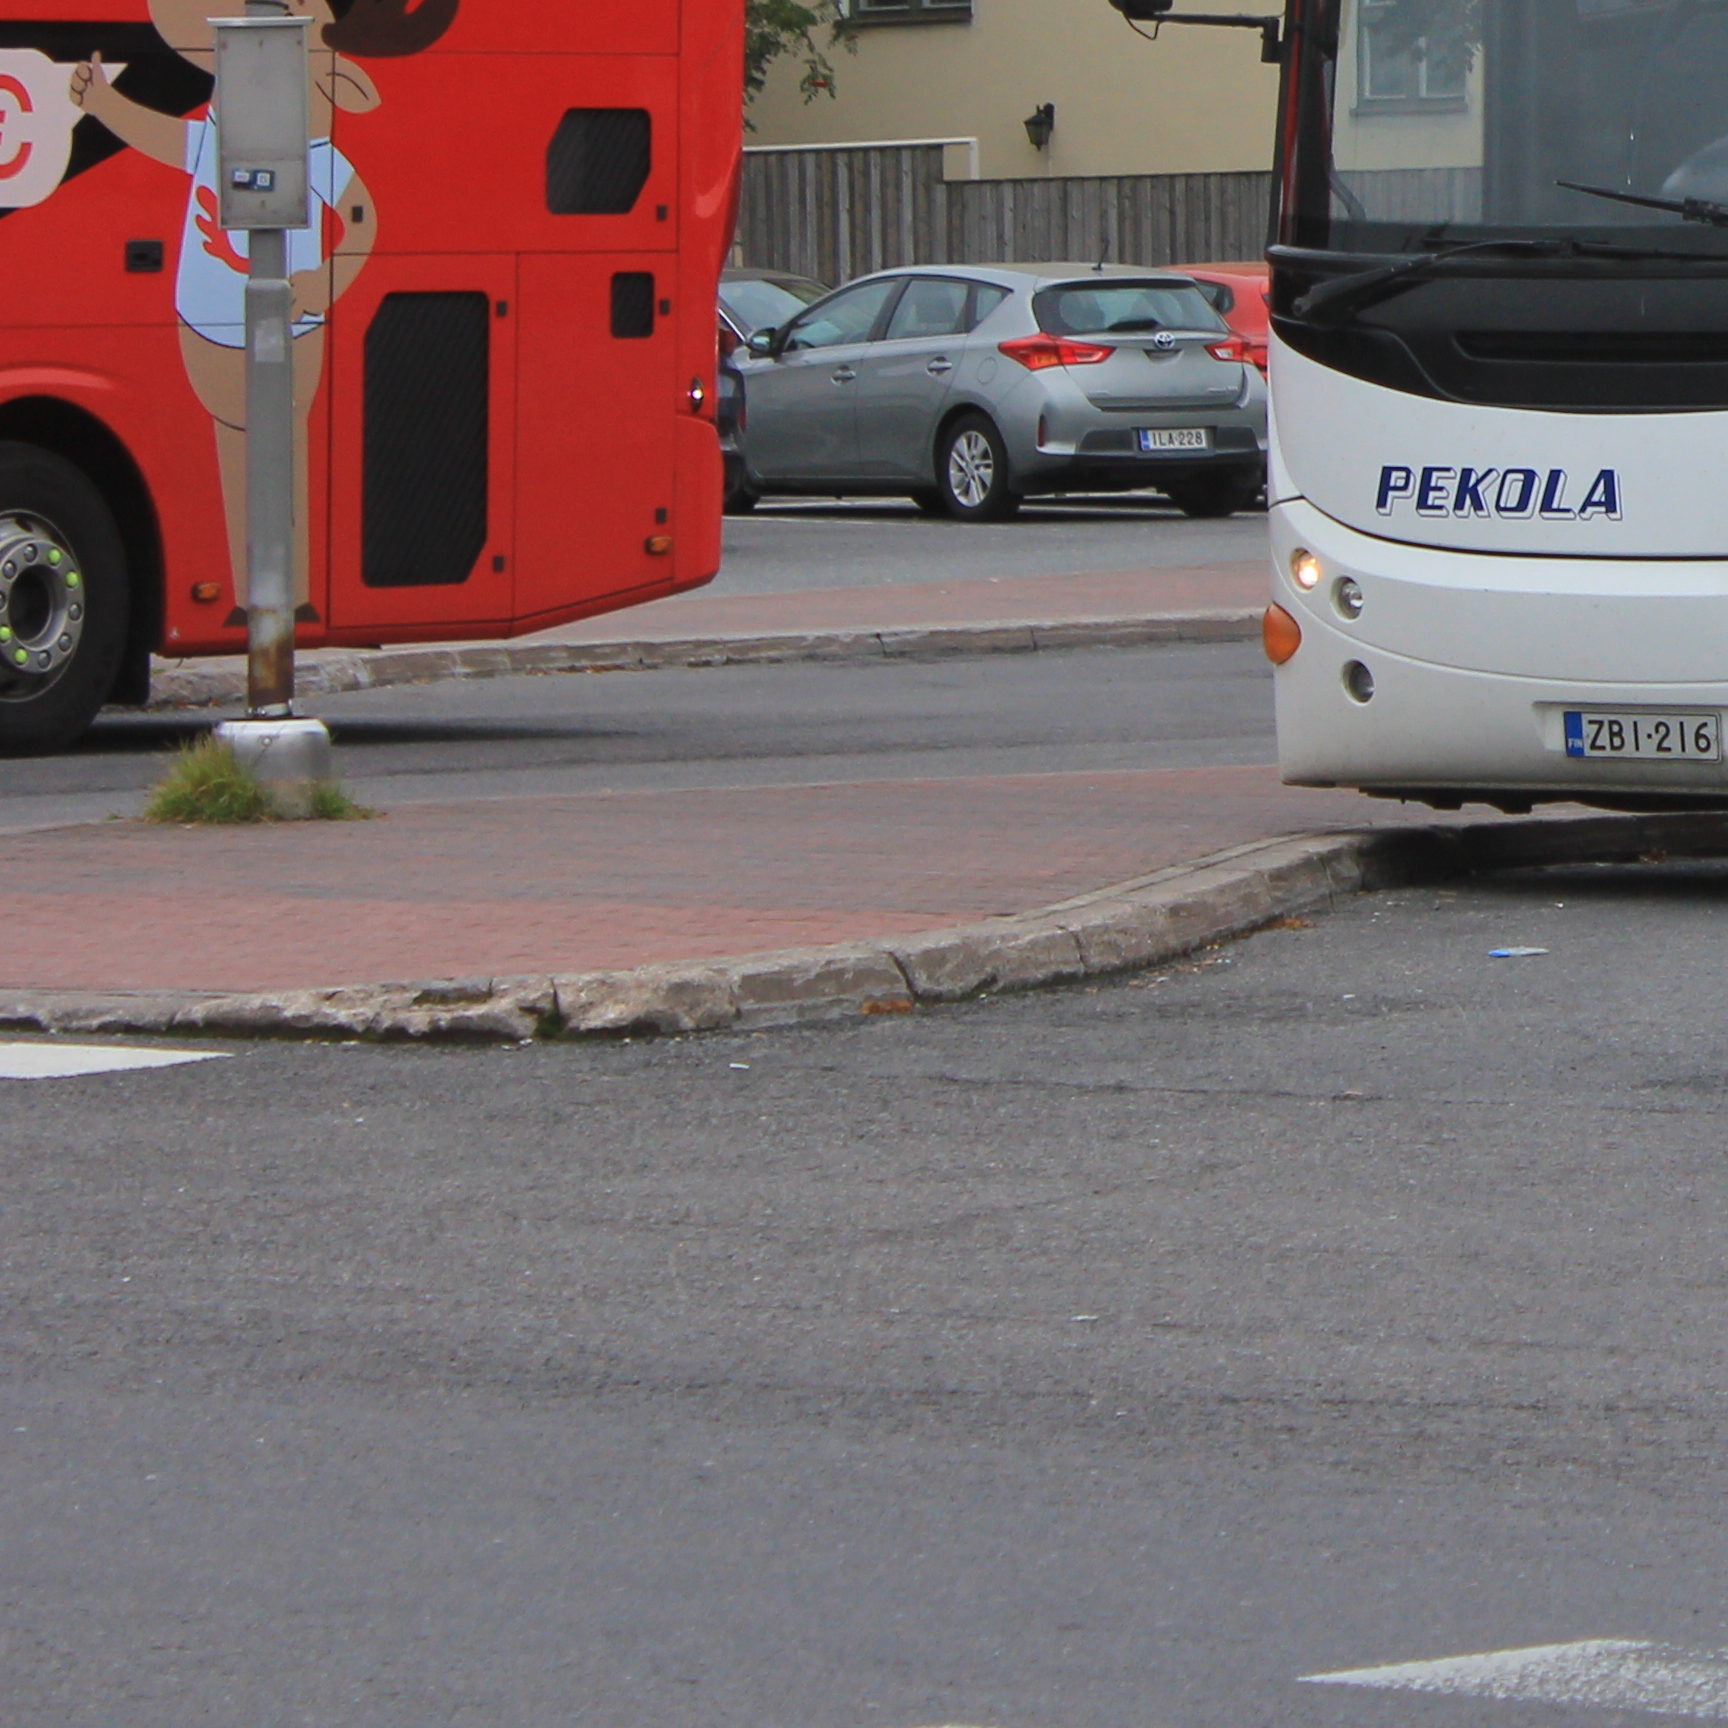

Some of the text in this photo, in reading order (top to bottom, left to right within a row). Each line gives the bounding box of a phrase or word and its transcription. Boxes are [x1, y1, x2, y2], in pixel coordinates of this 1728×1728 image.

[1151, 429, 1204, 447] ILA-228
[1376, 465, 1623, 521] PEKOLA
[1587, 719, 1712, 753] ZBI-216
